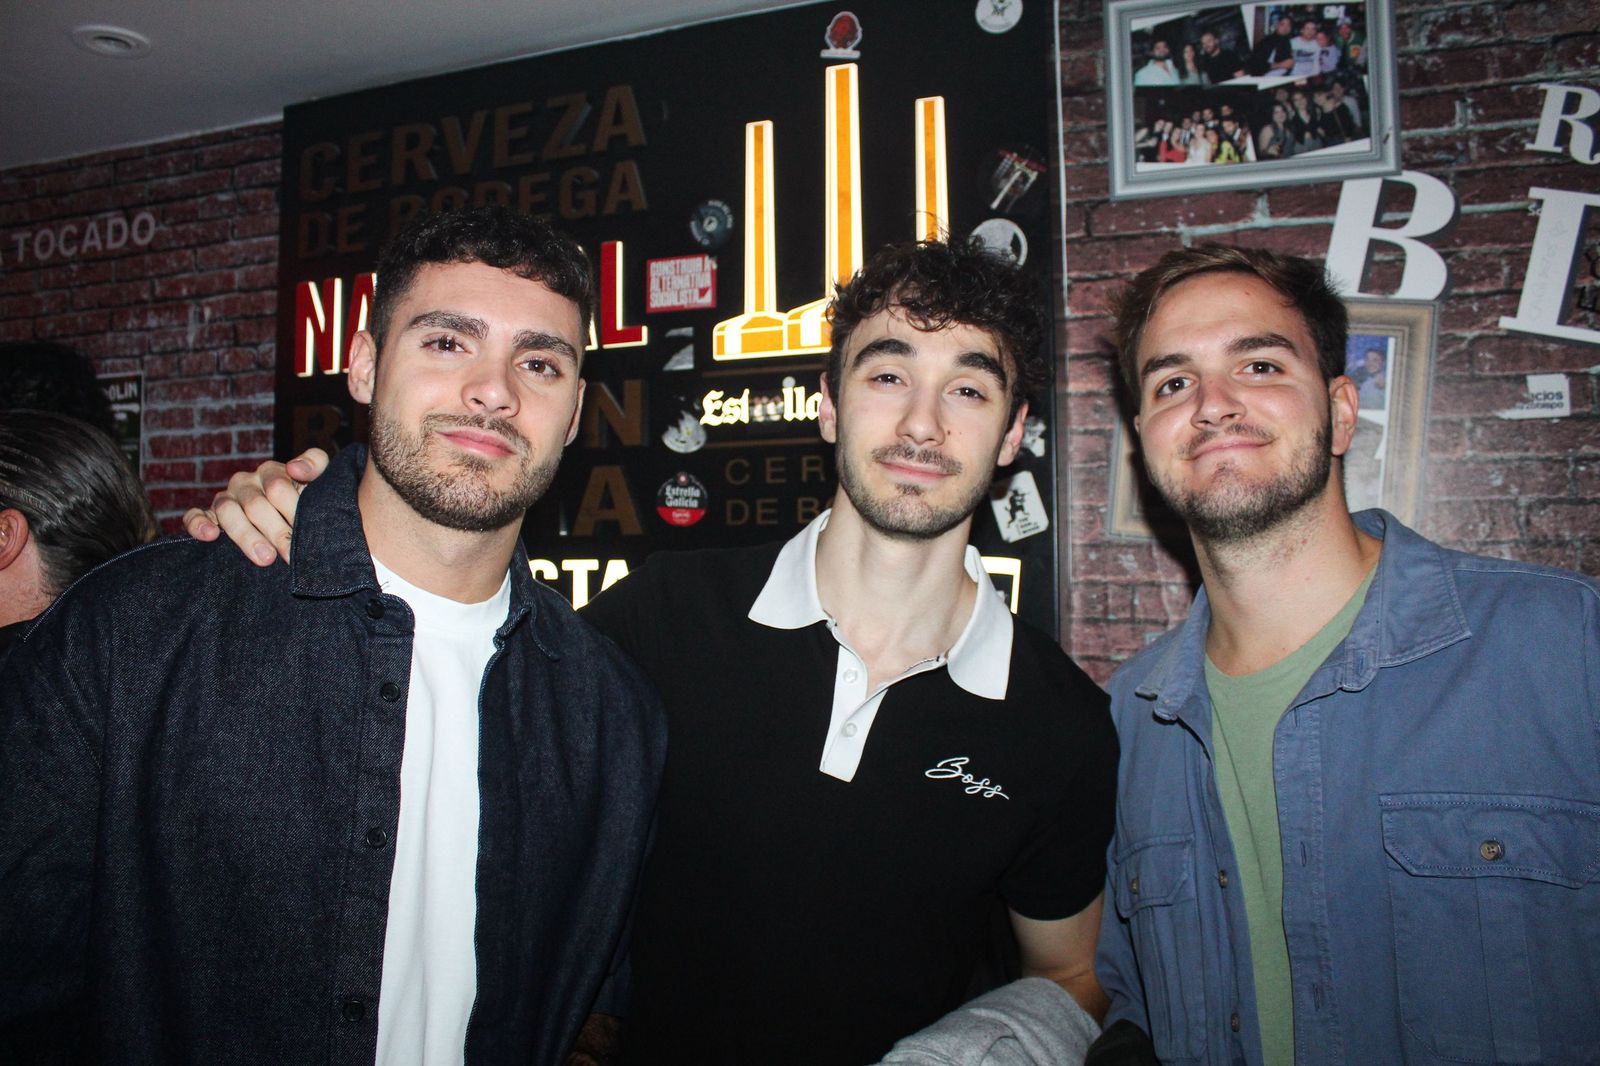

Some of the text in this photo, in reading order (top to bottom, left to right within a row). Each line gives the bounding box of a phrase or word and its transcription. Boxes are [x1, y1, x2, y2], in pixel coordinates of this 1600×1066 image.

[301, 84, 647, 201] CERVEZA
[11, 211, 156, 263] TOCADO
[726, 498, 778, 526] DE
[925, 757, 1010, 800] Boss
